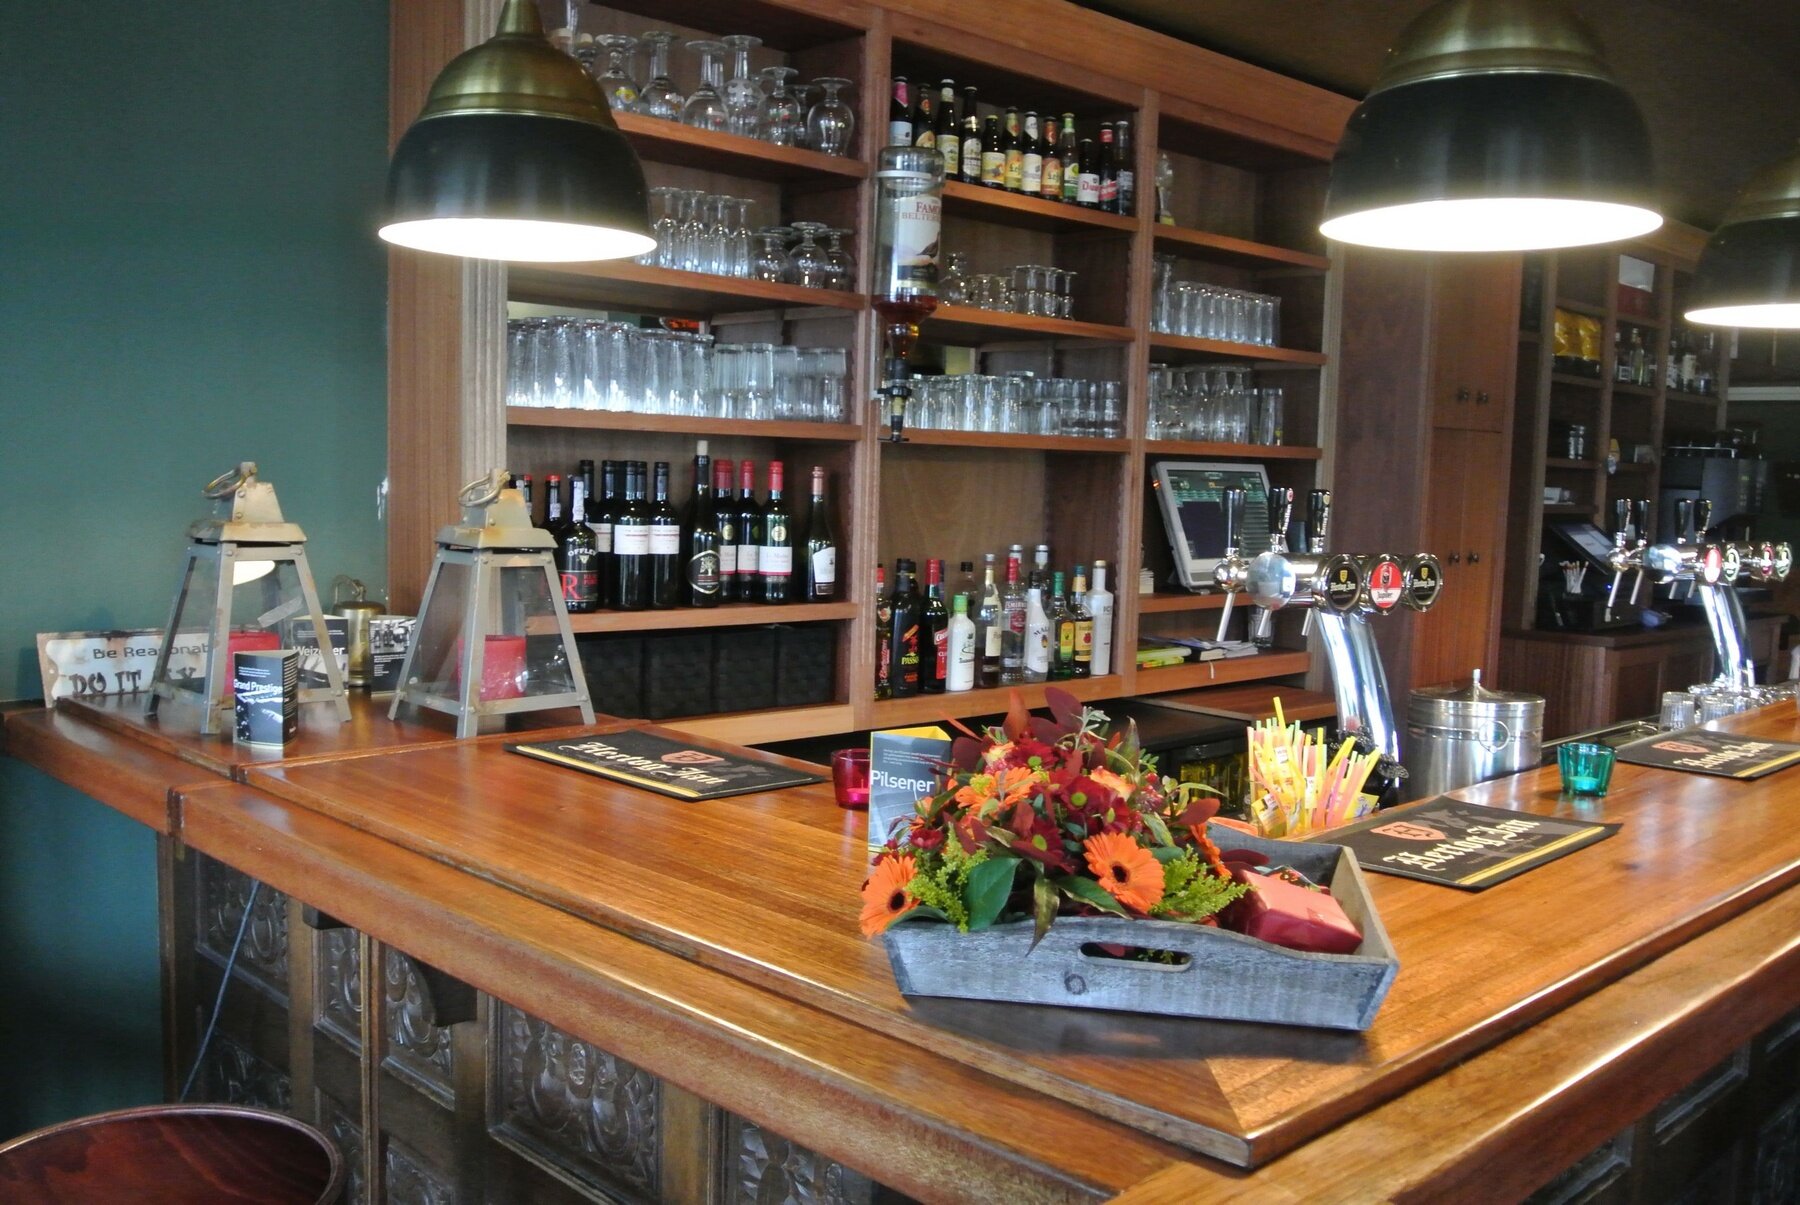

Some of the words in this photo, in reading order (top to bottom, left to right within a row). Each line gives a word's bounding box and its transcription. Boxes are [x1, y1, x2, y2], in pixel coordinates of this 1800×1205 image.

[92, 647, 117, 660] Be
[292, 645, 346, 656] Weizer
[68, 671, 107, 697] DO
[114, 669, 142, 693] IT
[233, 678, 251, 691] Grand
[250, 681, 284, 696] Prestige
[870, 769, 935, 793] Pilsener
[1382, 835, 1505, 872] Hertog
[1466, 818, 1541, 843] Jan
